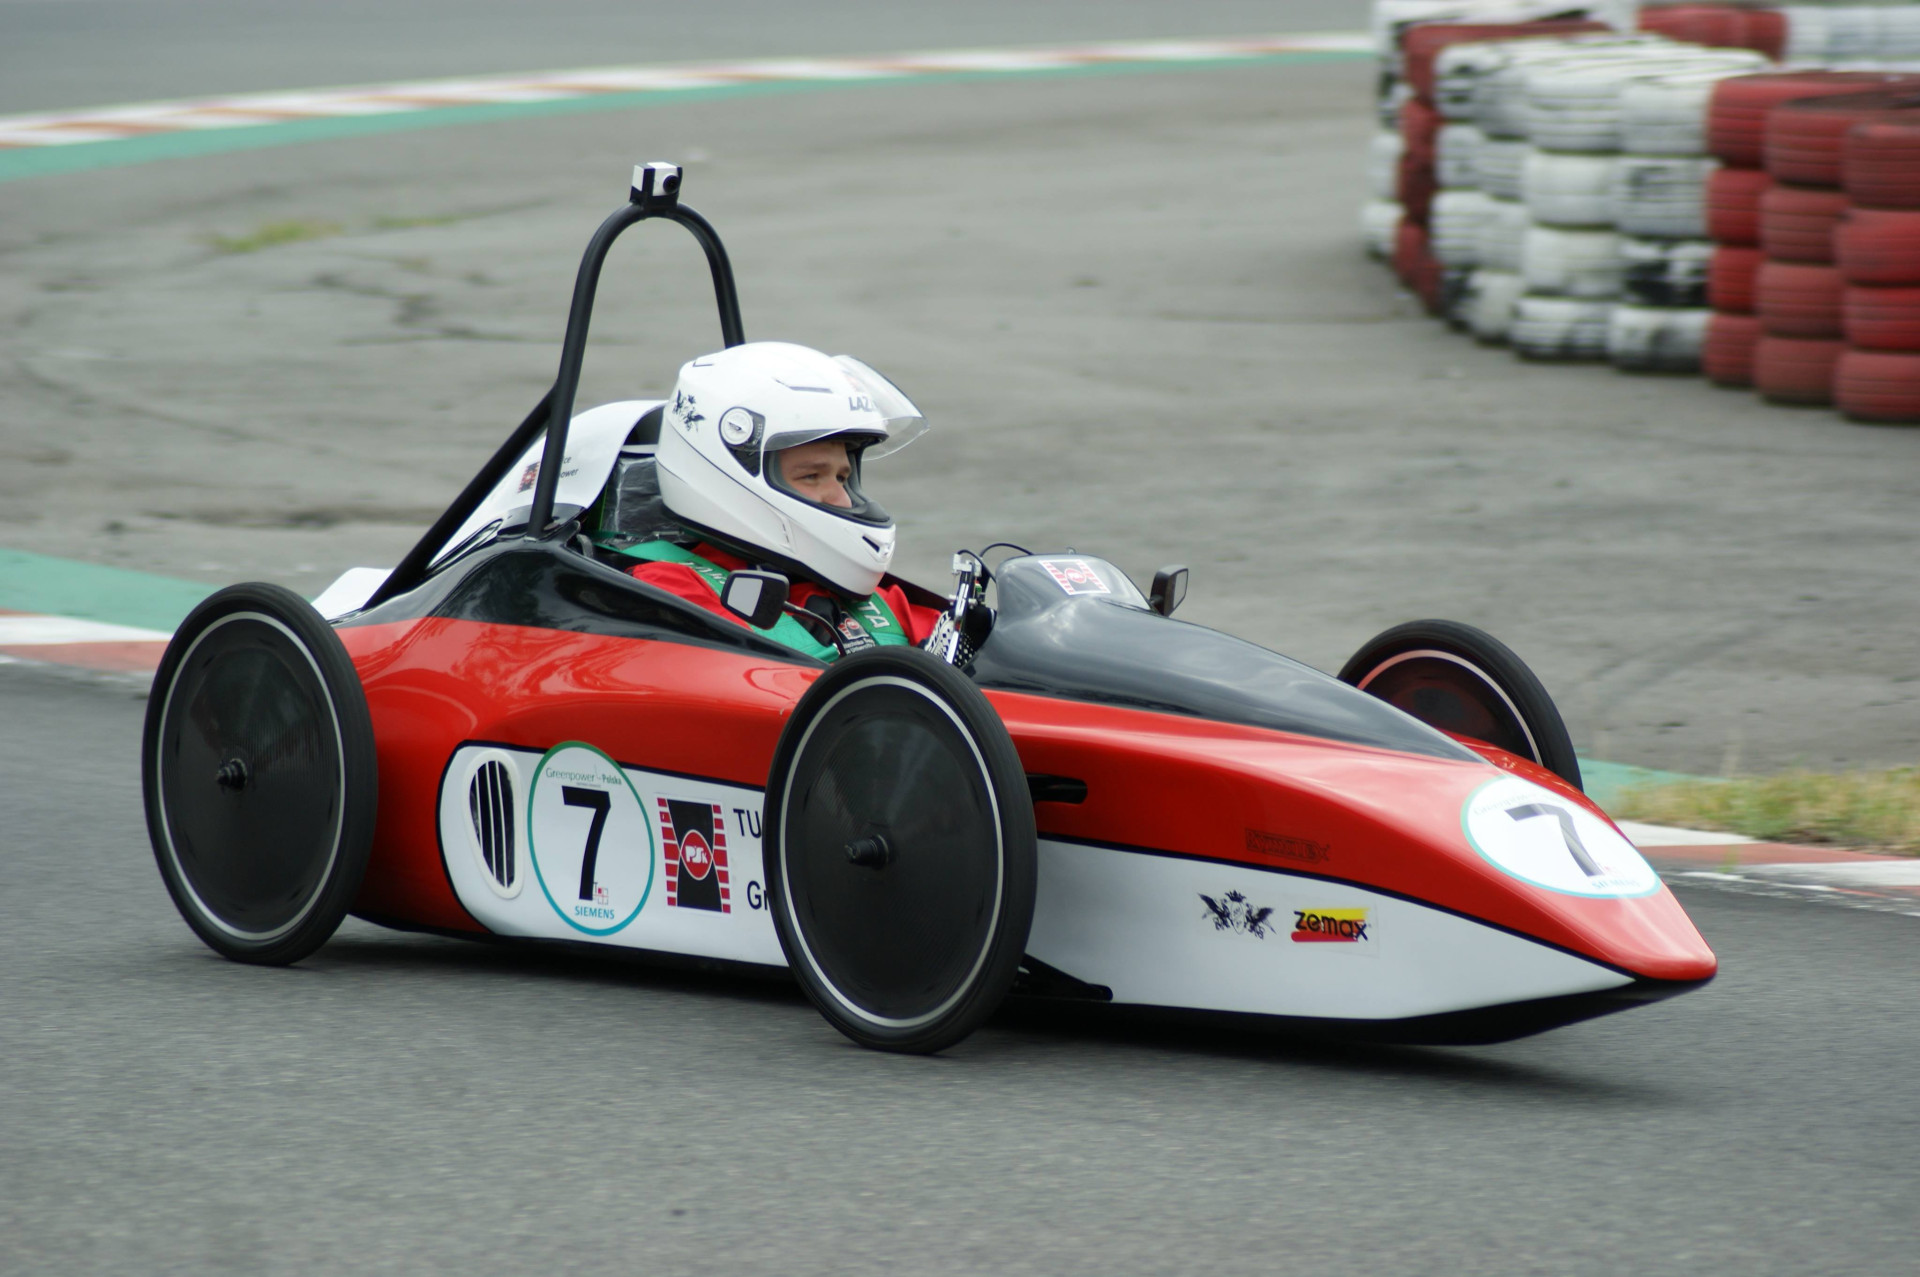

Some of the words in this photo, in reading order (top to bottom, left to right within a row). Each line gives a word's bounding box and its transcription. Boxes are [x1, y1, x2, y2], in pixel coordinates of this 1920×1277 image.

[848, 396, 873, 412] LAZ
[858, 601, 890, 628] TA
[546, 767, 595, 781] Greenpower
[732, 808, 763, 838] TU
[562, 785, 611, 901] 7
[1504, 802, 1605, 877] 7
[574, 905, 615, 920] SIEMENS
[1293, 910, 1369, 942] zemax
